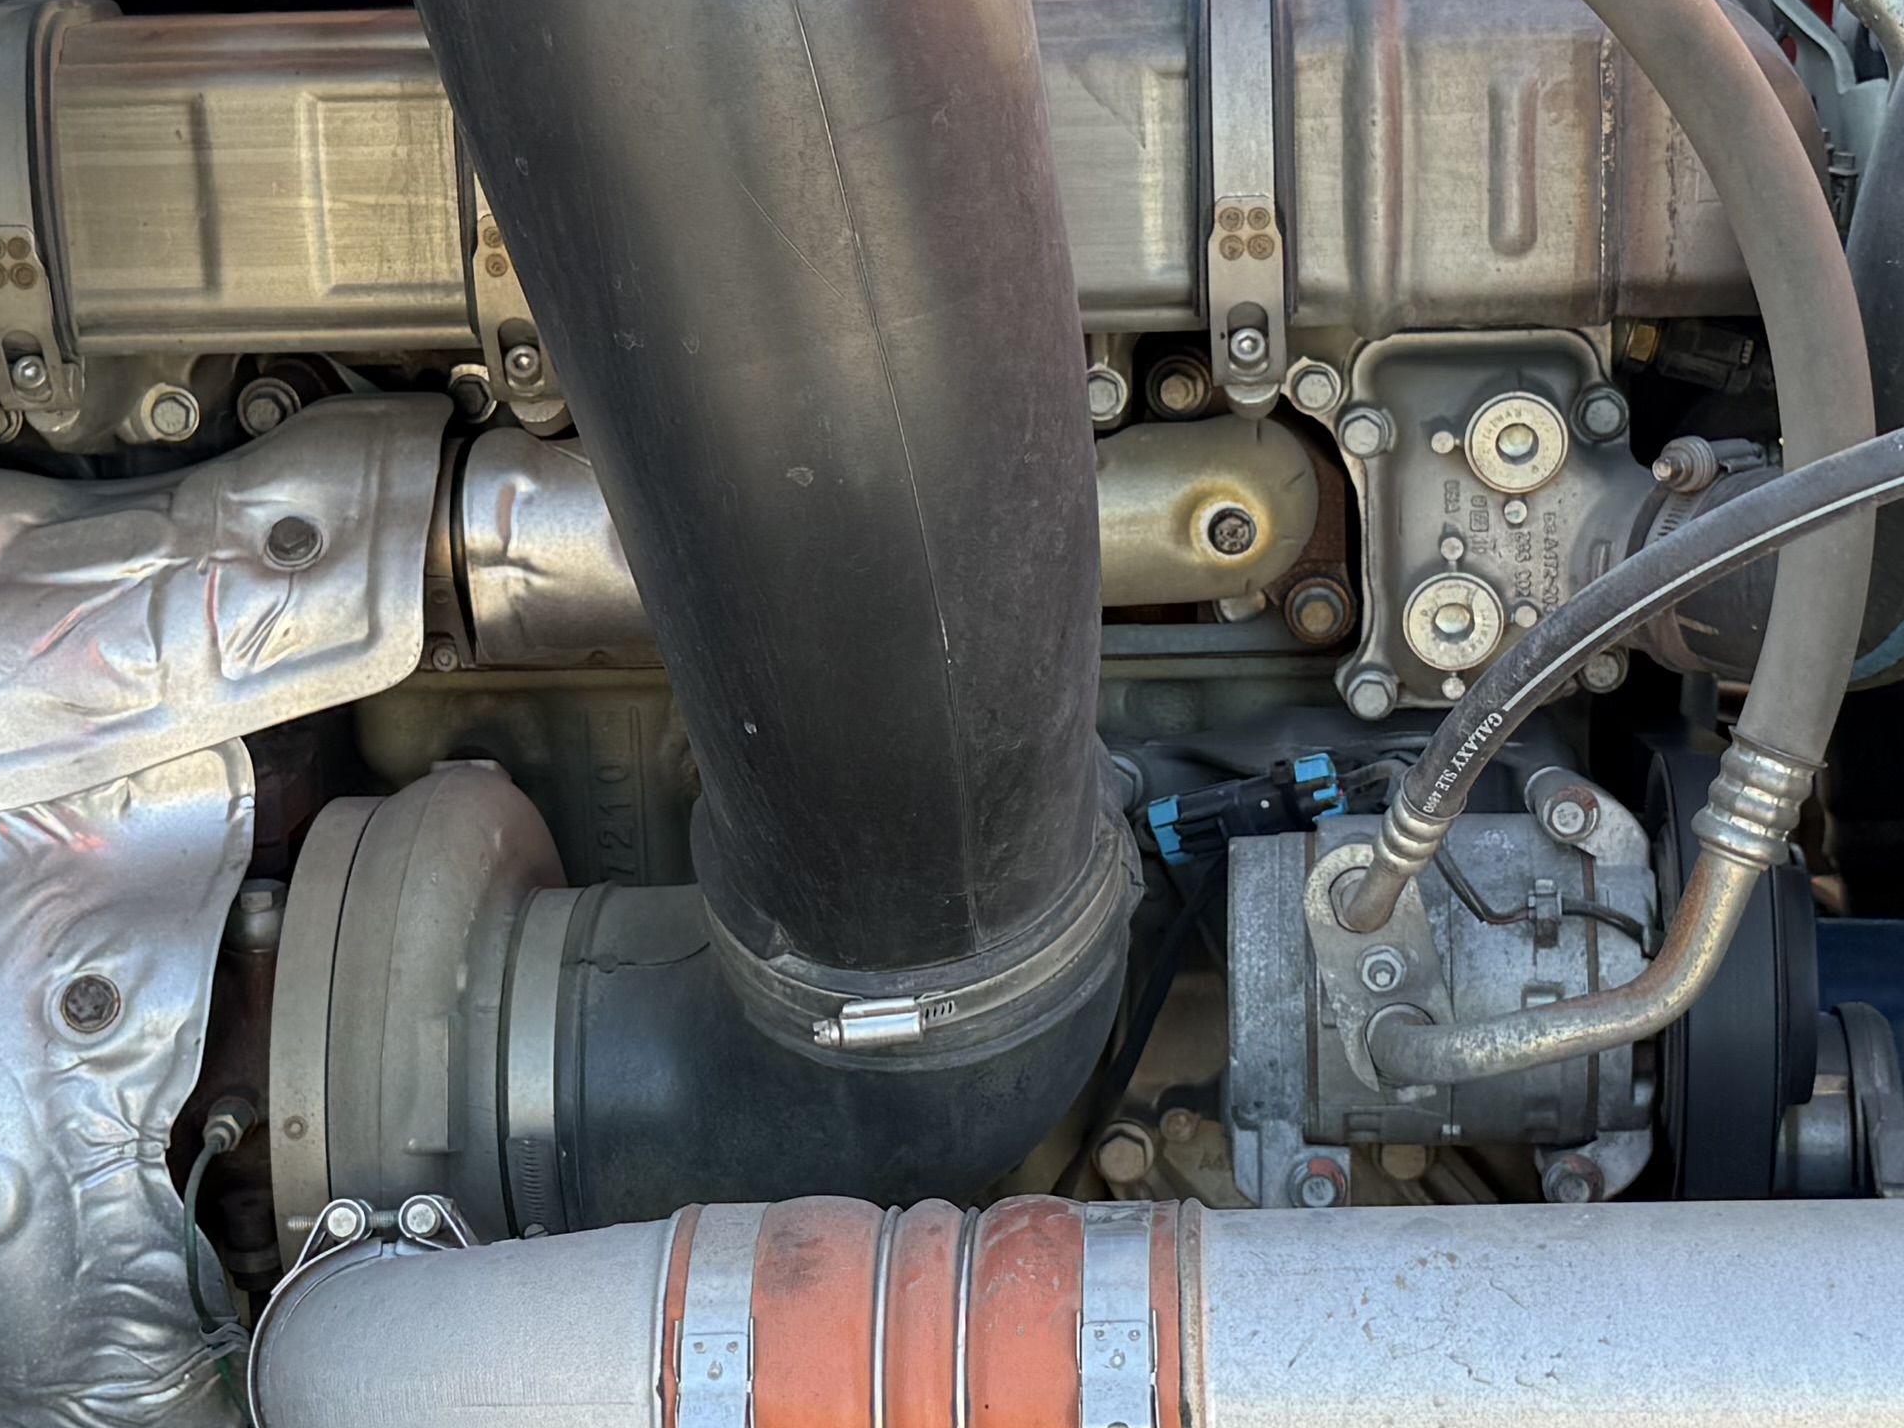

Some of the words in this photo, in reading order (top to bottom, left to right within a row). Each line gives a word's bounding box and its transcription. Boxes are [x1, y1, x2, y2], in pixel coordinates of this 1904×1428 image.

[1444, 480, 1460, 513] USA
[1451, 712, 1503, 772] GALAXY
[1435, 769, 1458, 791] SLE
